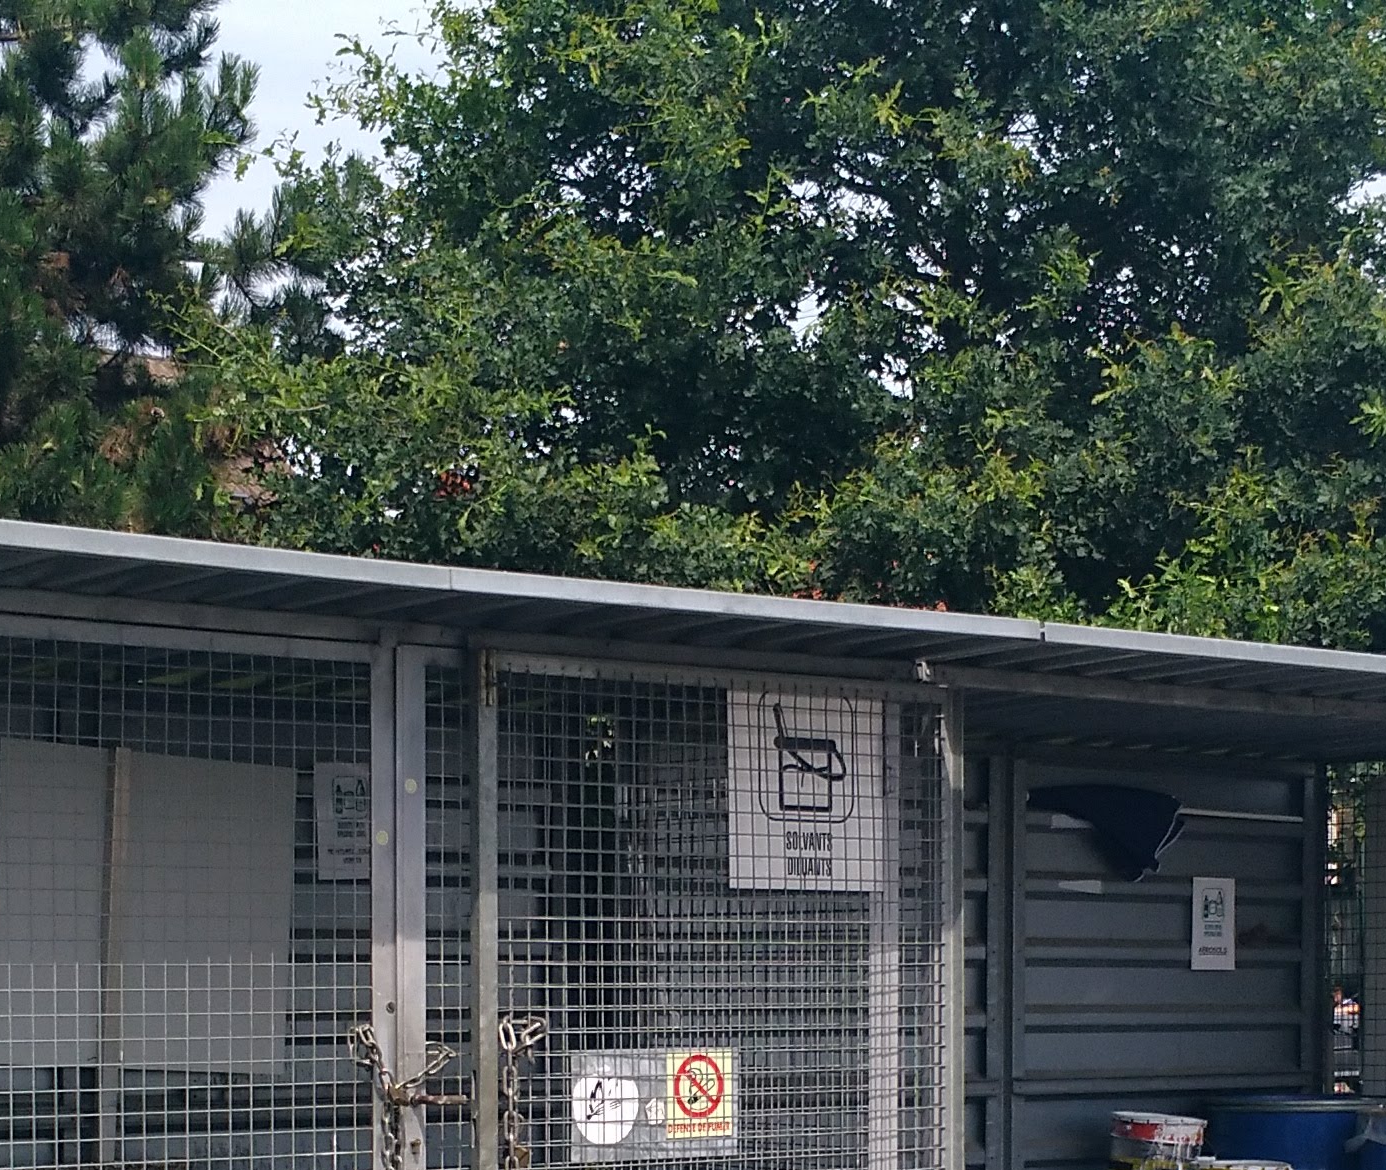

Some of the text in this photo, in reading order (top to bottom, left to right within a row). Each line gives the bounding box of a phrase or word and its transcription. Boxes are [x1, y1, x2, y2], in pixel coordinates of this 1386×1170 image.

[786, 831, 833, 851] SOLVANTS
[787, 857, 832, 877] DILUANTS
[668, 1123, 696, 1133] DEFENSE
[697, 1122, 707, 1132] DE
